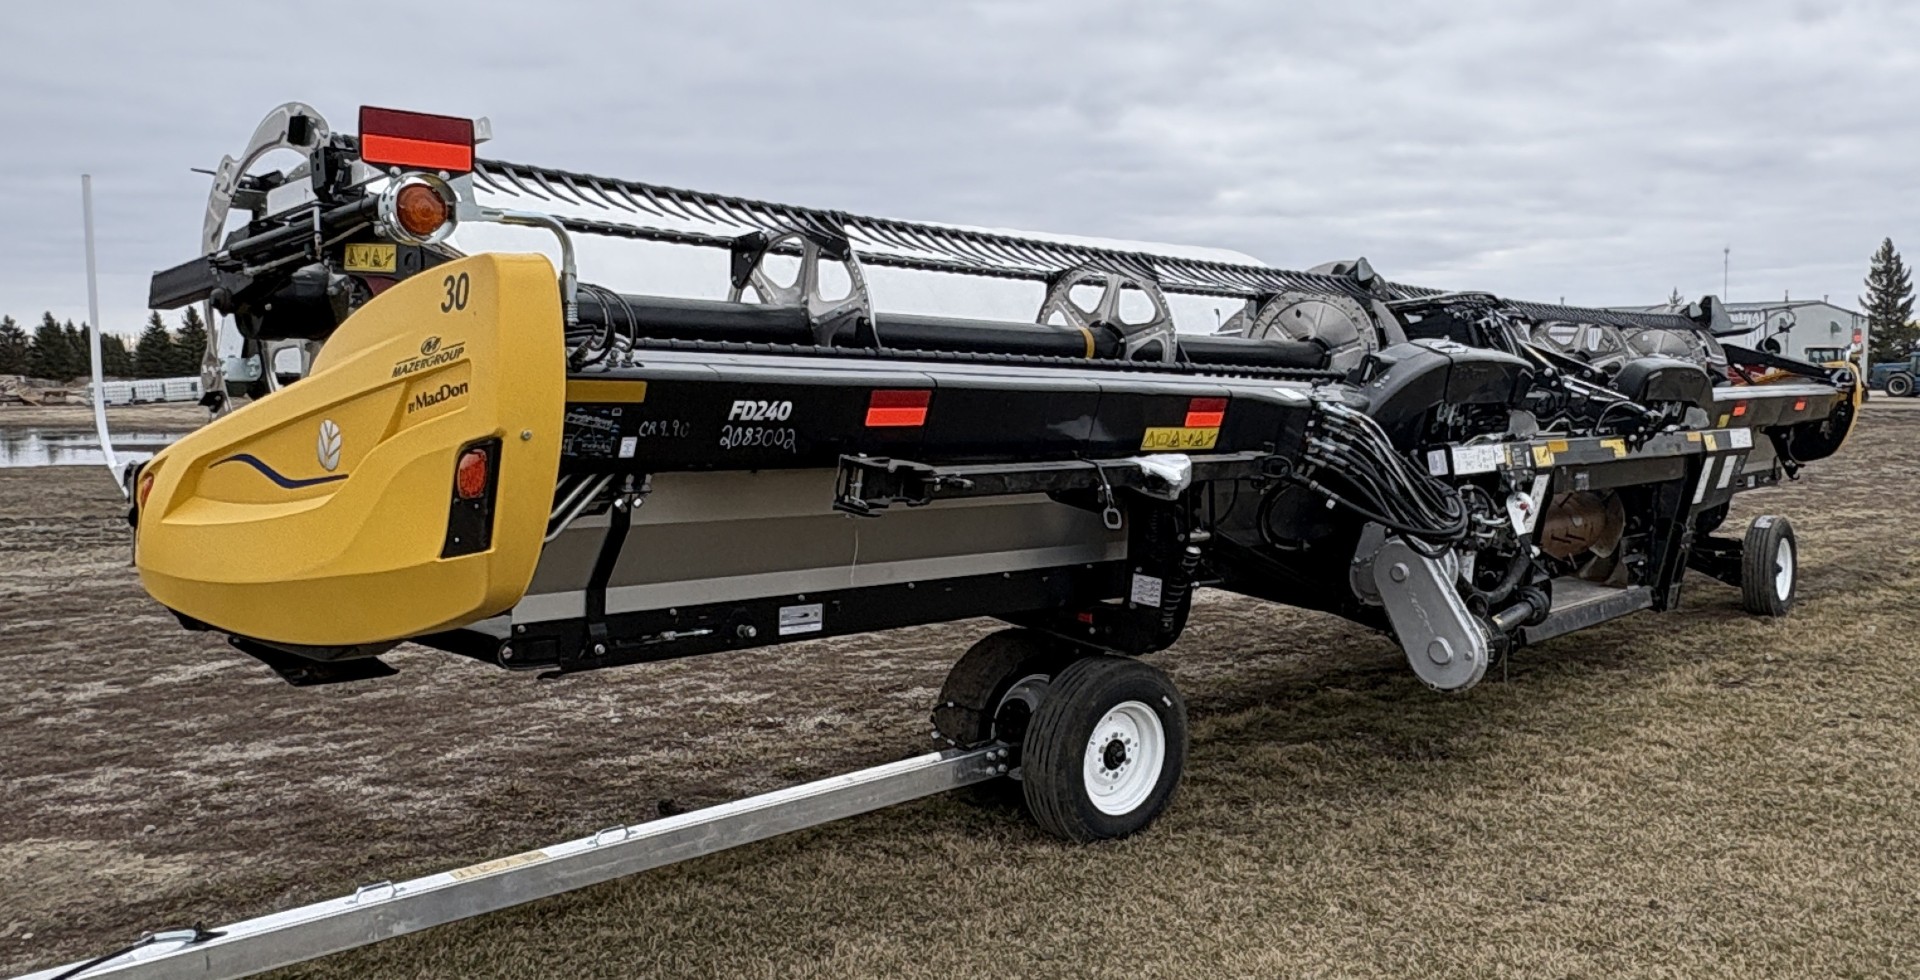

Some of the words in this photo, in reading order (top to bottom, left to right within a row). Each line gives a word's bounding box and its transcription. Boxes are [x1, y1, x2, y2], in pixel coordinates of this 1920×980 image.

[441, 271, 469, 313] 30
[392, 347, 464, 378] MAZERGROUP
[416, 382, 468, 411] MacDon
[728, 400, 793, 421] FD240
[719, 424, 797, 454] 2083002
